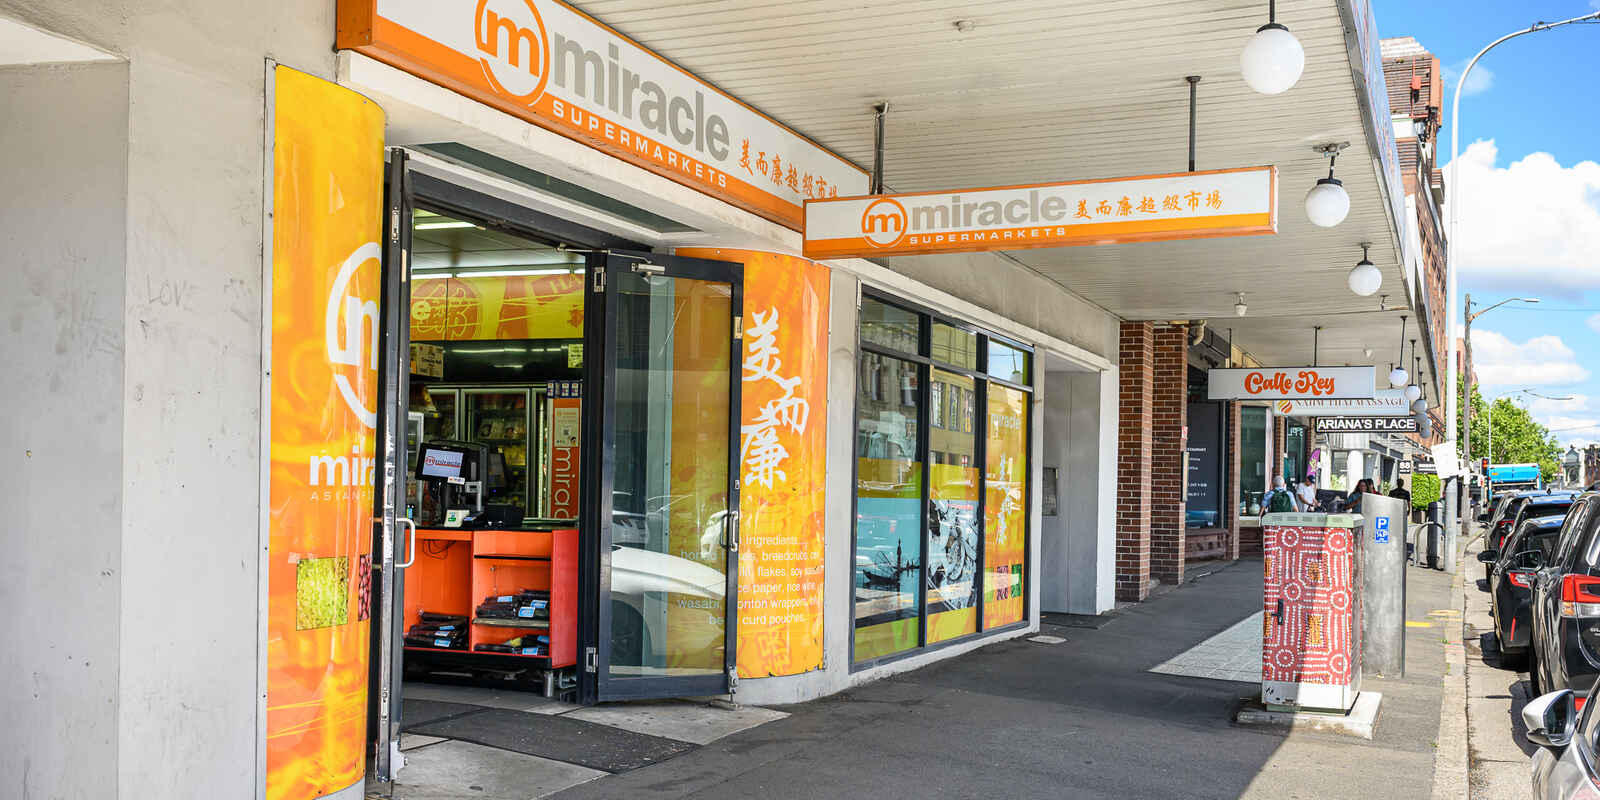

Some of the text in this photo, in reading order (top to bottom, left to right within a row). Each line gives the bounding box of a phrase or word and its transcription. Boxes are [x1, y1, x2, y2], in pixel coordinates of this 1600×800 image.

[554, 31, 730, 162] miracle
[552, 100, 728, 188] SUPERMARKETS
[911, 190, 1067, 231] miracle
[909, 227, 1066, 244] SUPERMARKETS
[1244, 370, 1335, 396] Calle Rey
[1318, 419, 1414, 429] ARIANA'S PLACE
[1377, 518, 1387, 529] P
[737, 600, 768, 609] onton
